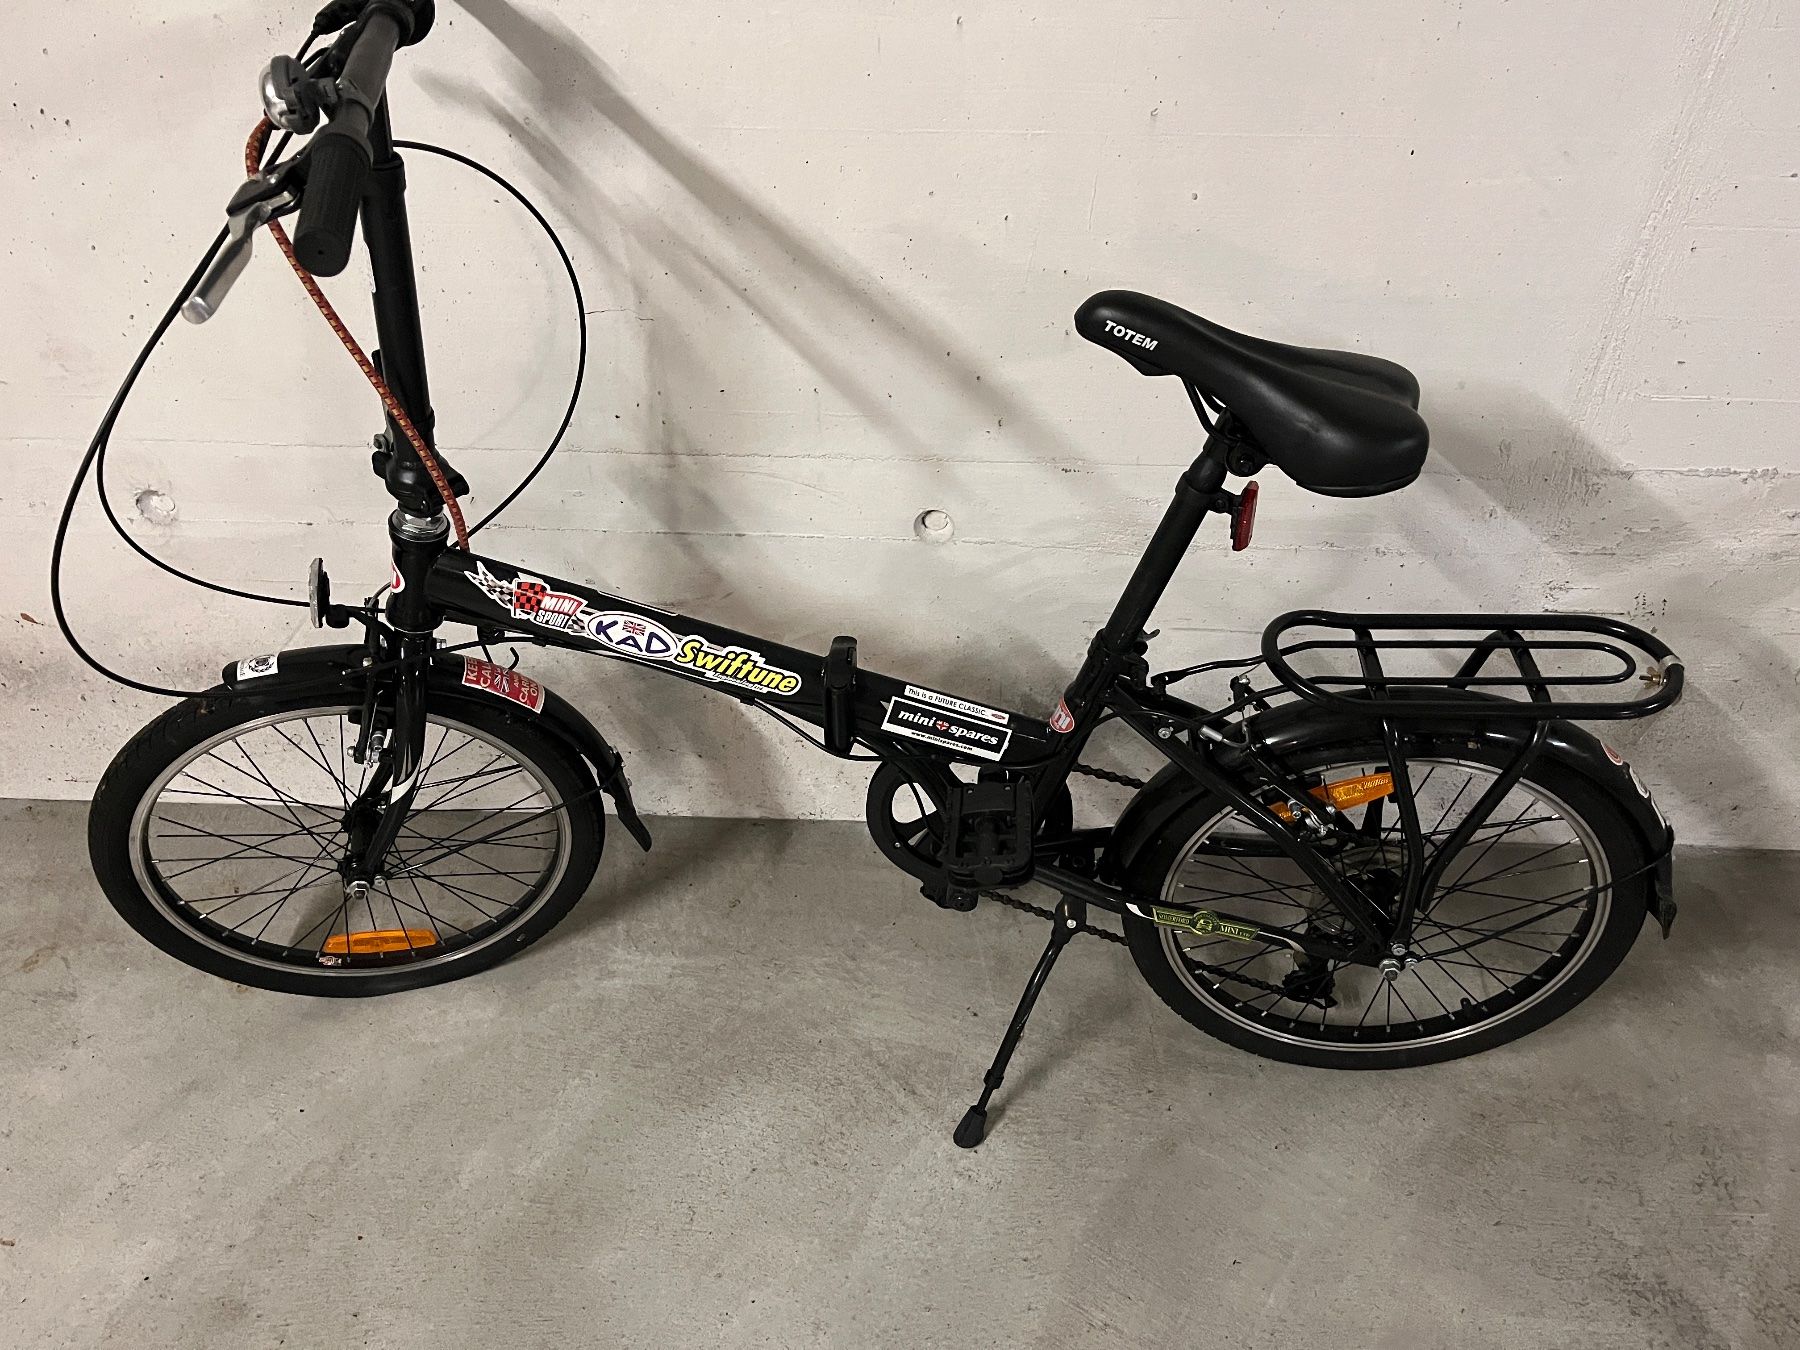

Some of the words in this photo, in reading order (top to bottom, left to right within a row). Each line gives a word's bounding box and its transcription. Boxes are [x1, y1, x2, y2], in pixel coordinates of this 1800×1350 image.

[1104, 320, 1158, 351] TOTEM
[540, 595, 579, 615] MINI
[536, 609, 570, 628] SPORT
[595, 620, 671, 654] KAD
[466, 657, 478, 680] KEE
[480, 662, 491, 688] CAL
[675, 638, 799, 693] Swiftune
[908, 688, 920, 697] This
[934, 695, 957, 708] FUTURE
[897, 709, 935, 727] mini
[948, 724, 999, 746] spares
[1221, 925, 1239, 935] MINI
